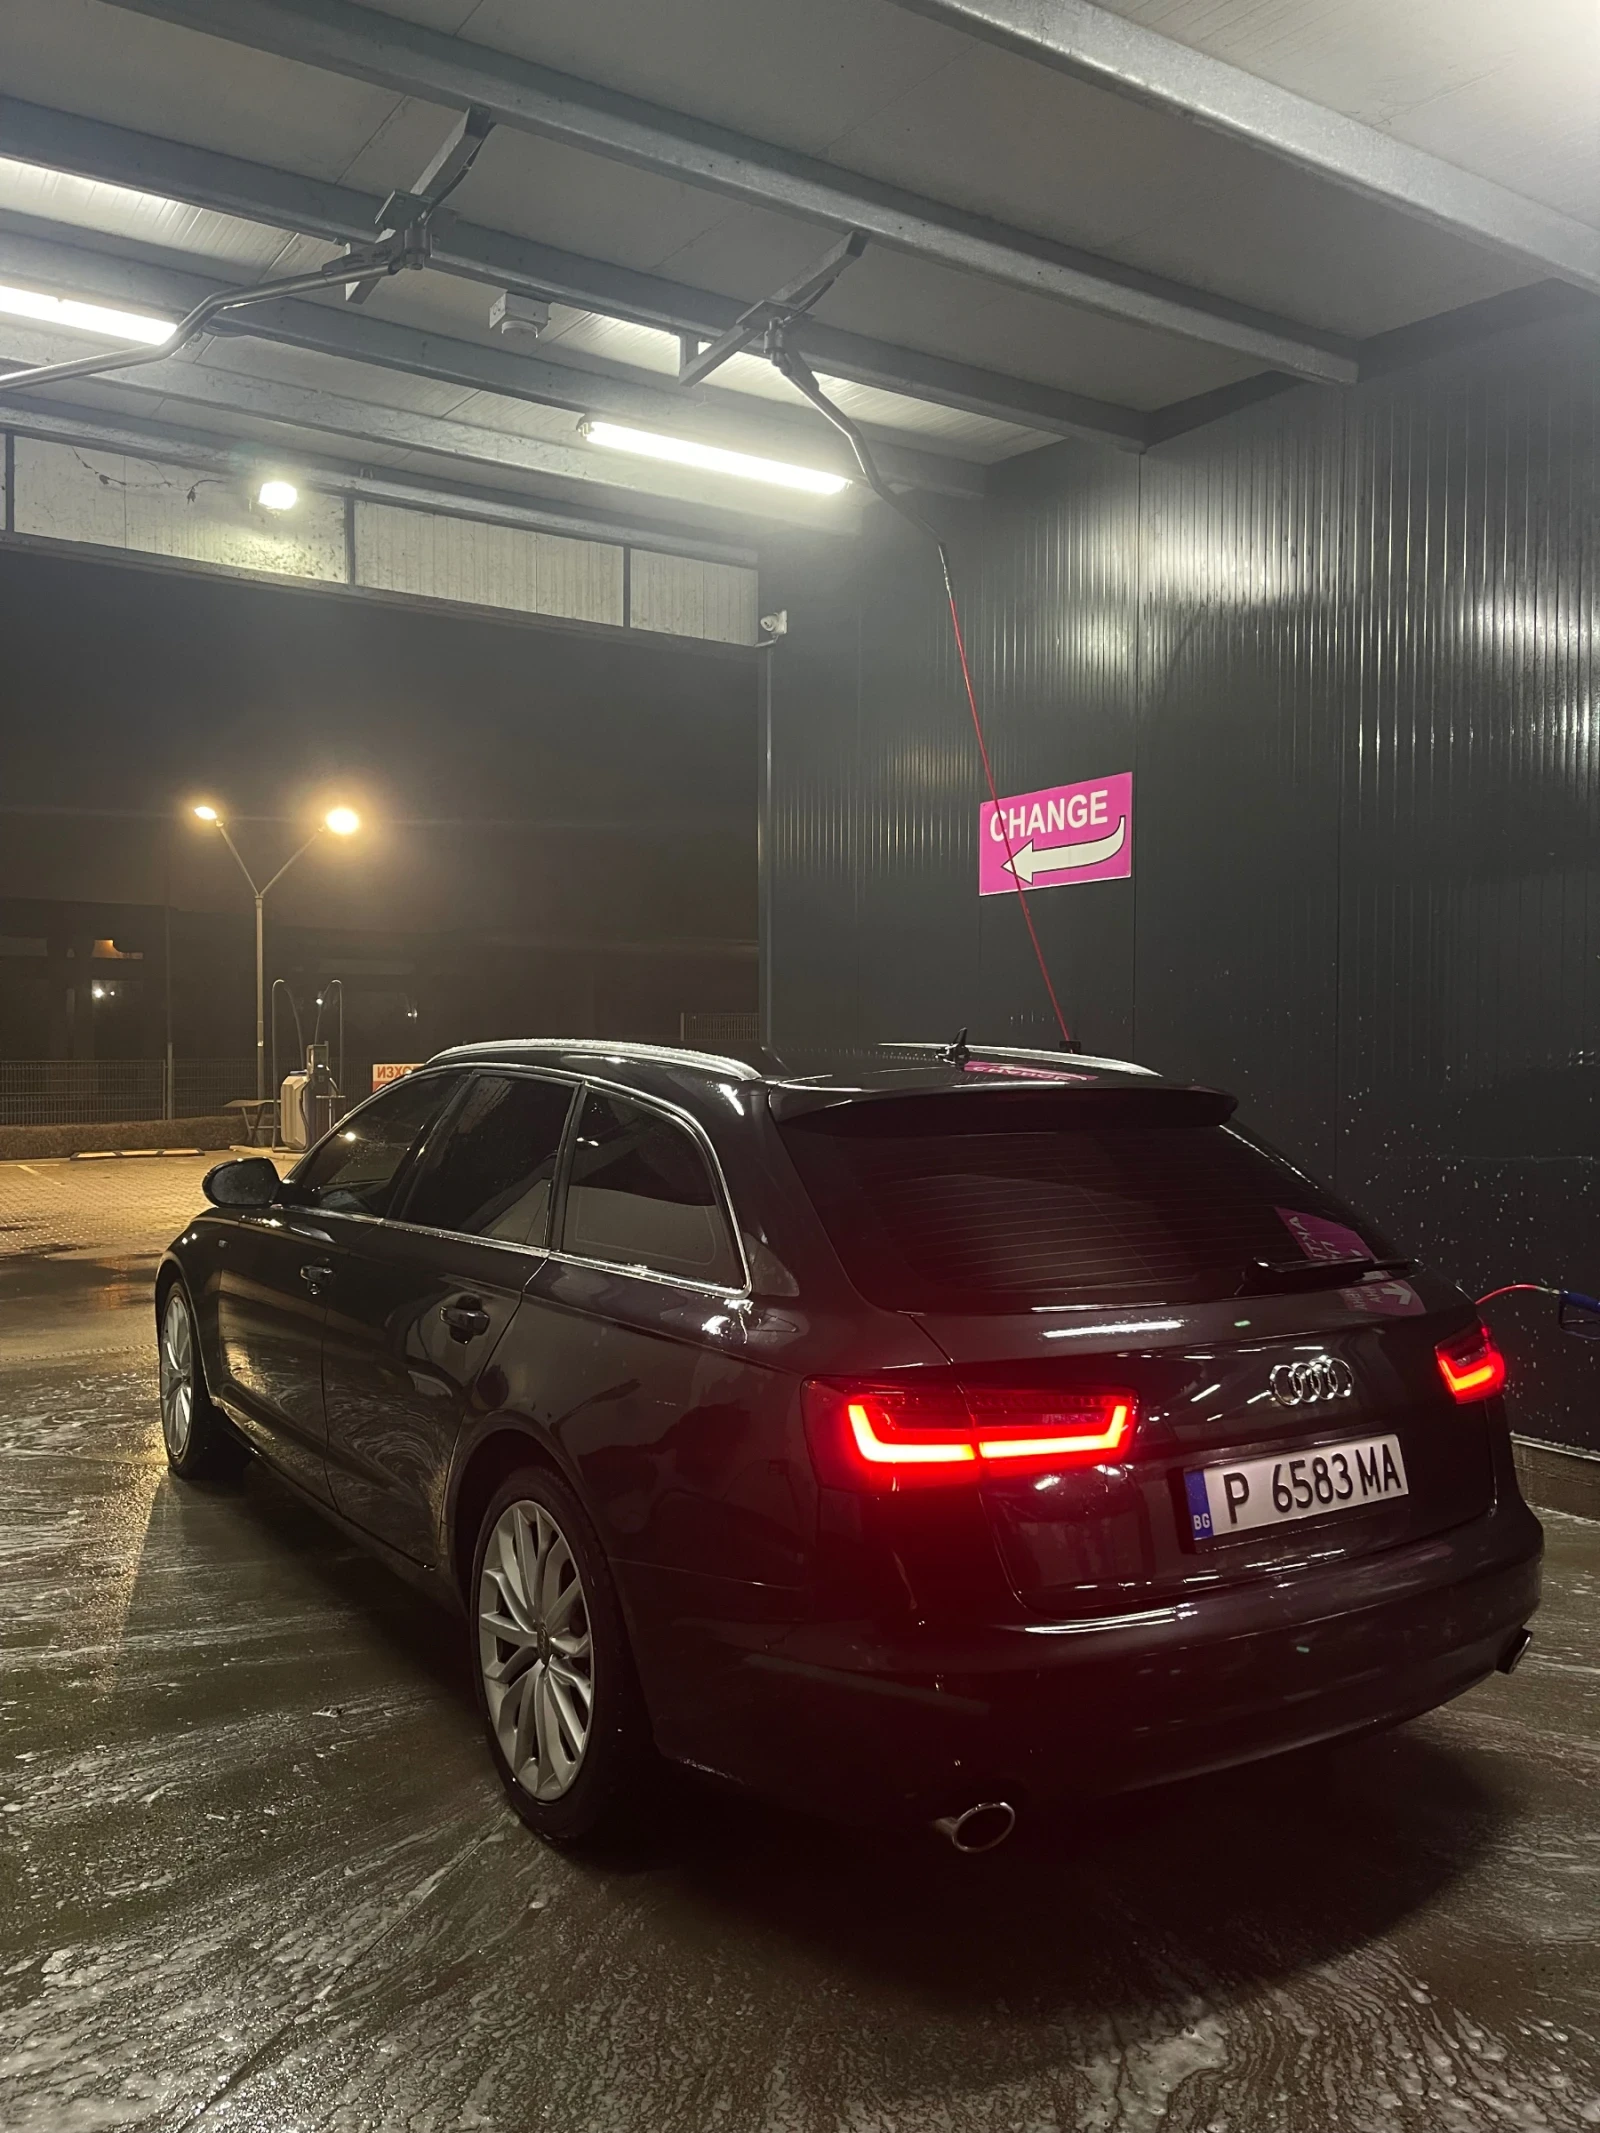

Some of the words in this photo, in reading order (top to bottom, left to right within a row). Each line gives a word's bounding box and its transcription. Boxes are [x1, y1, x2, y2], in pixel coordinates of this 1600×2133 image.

[990, 790, 1108, 841] CHANGE
[377, 1066, 420, 1078] ИЗХО
[1223, 1472, 1250, 1524] P
[1273, 1453, 1353, 1513] 6583
[1356, 1443, 1402, 1496] MA
[1193, 1513, 1211, 1530] BG
